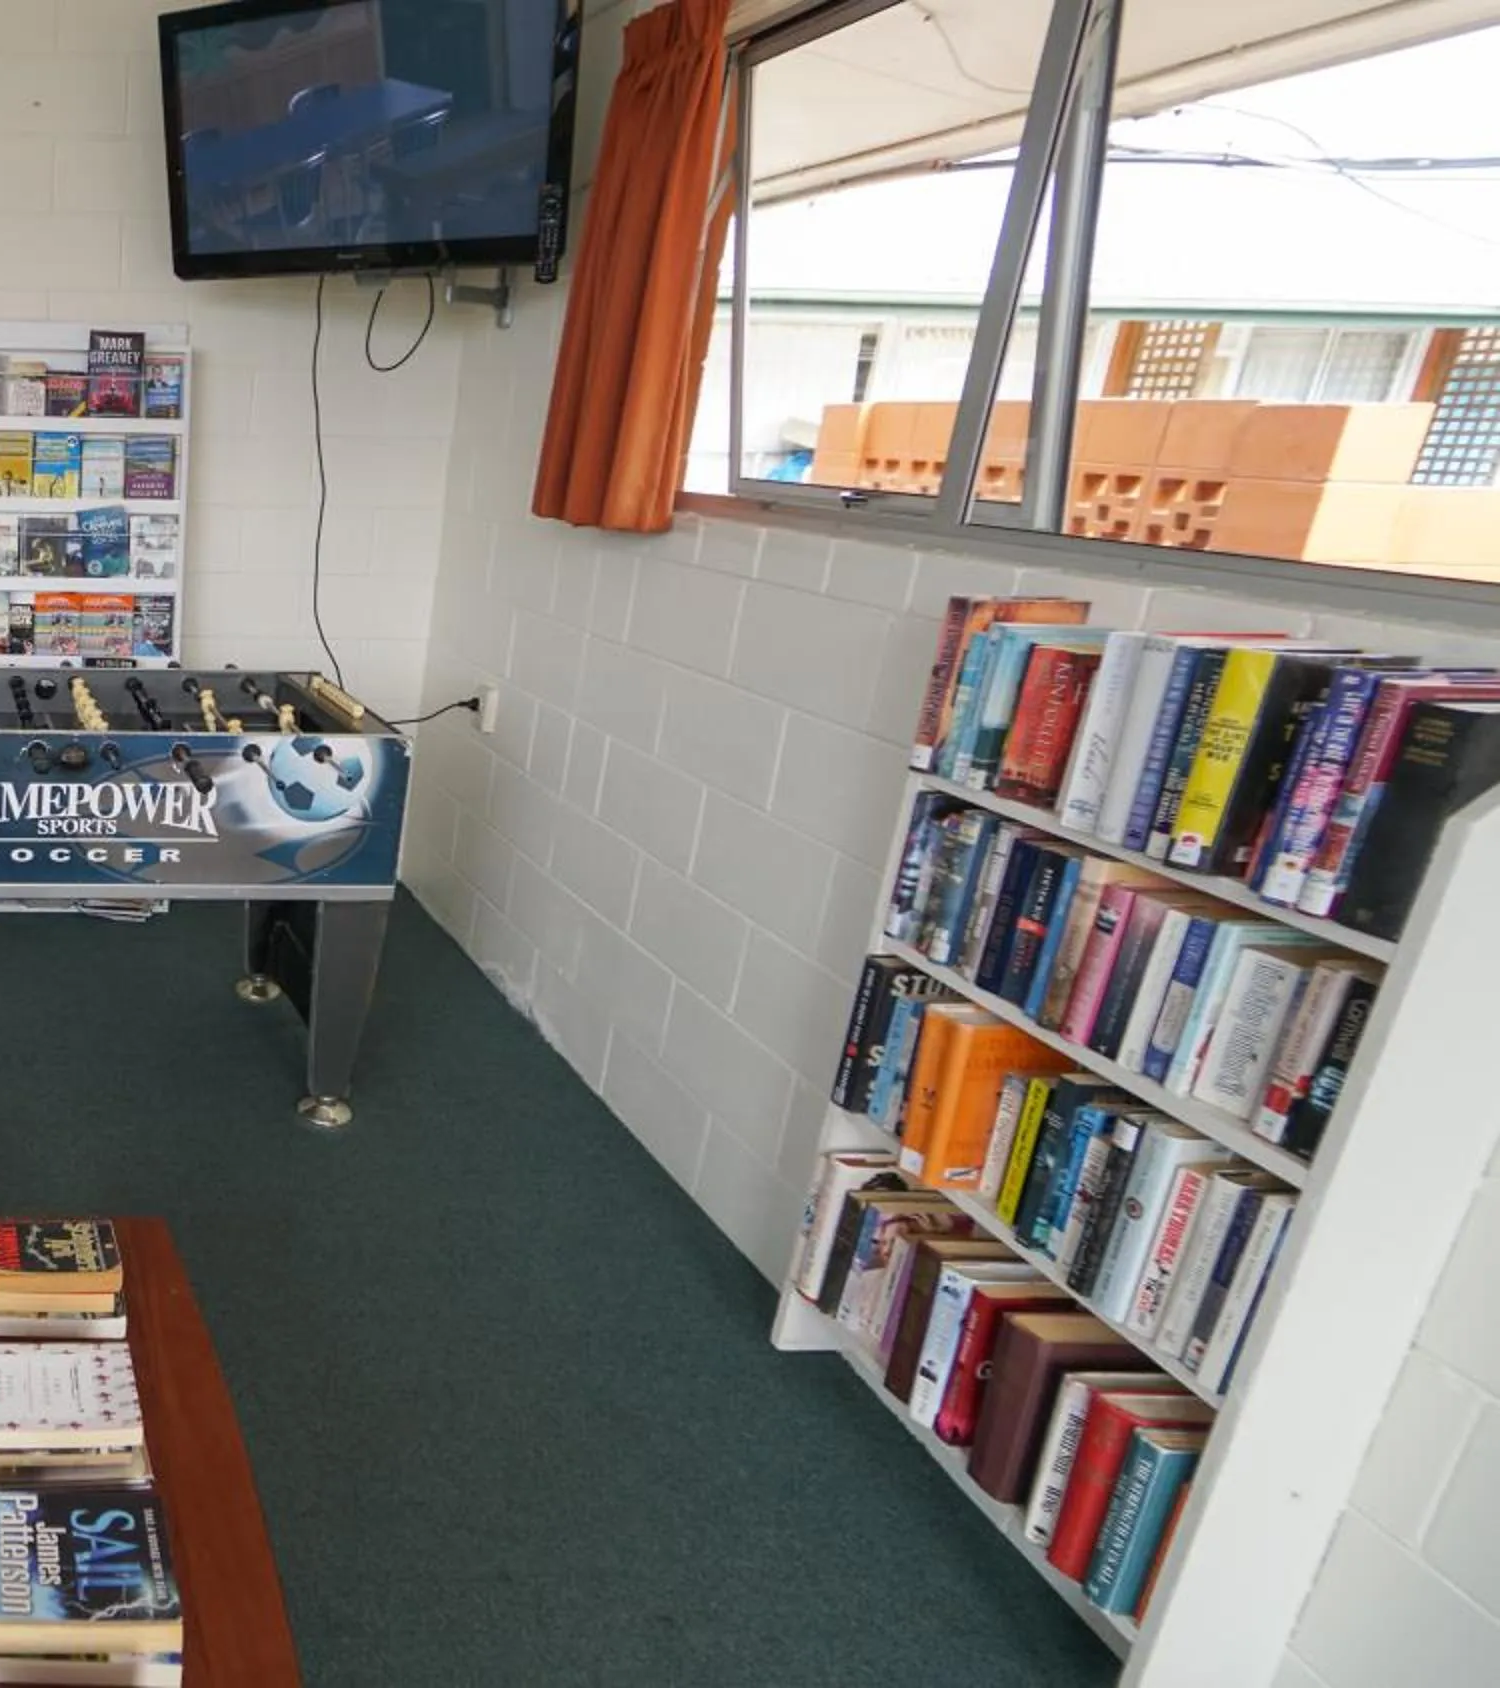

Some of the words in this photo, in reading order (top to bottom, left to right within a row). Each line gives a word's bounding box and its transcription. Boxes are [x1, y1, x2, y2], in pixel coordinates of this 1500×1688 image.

[99, 336, 133, 351] MARK
[89, 351, 141, 365] GREANEY
[37, 817, 118, 836] SPORTS
[35, 1521, 68, 1588] James
[70, 1506, 143, 1602] SAIL
